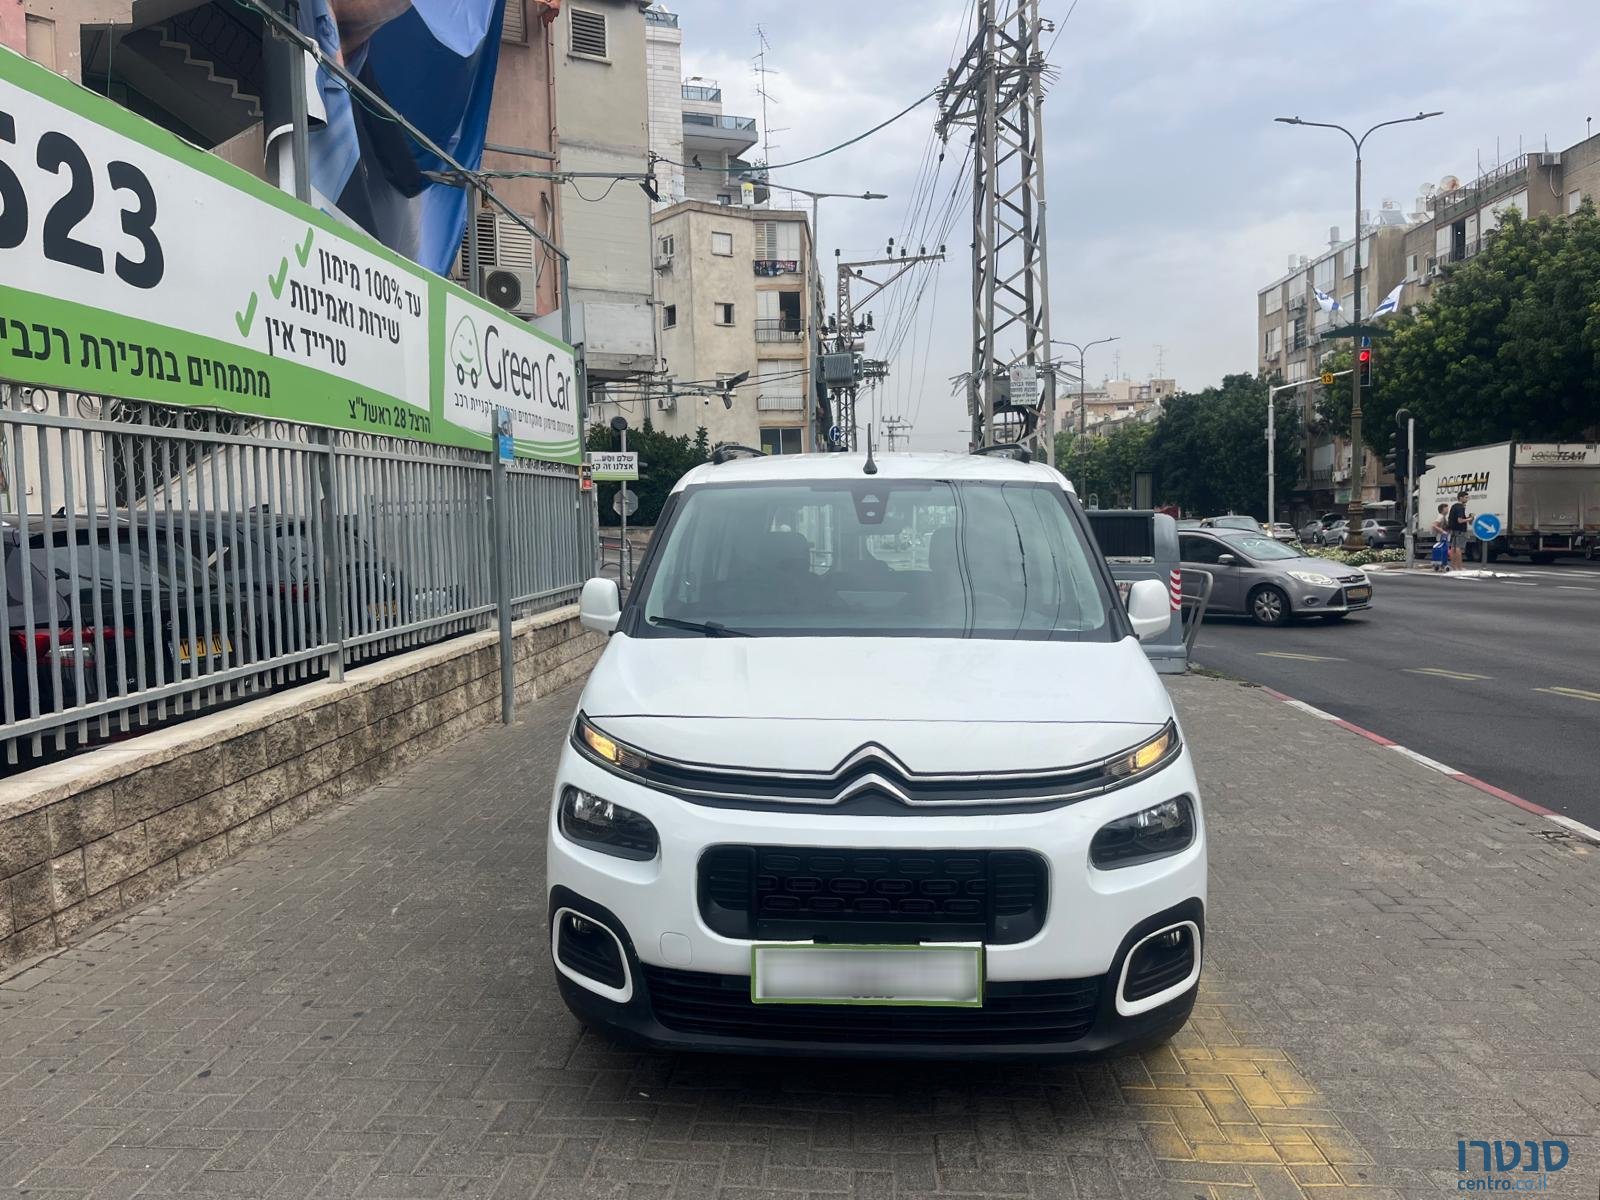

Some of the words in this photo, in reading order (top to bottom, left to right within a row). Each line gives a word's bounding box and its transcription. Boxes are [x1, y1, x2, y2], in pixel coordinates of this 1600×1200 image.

[318, 248, 361, 292] מימון
[365, 267, 402, 310] 100%
[290, 279, 354, 328] ואמינות
[404, 290, 421, 317] עד
[265, 316, 296, 356] אין
[358, 306, 400, 344] שירות
[79, 332, 181, 383] במכירת
[300, 327, 347, 366] טרייד
[187, 355, 271, 399] מתמחים
[484, 324, 542, 403] Green
[546, 353, 571, 412] Car
[1323, 374, 1332, 382] 13
[348, 396, 392, 426] ראשל"צ
[393, 405, 406, 429] 28
[454, 392, 469, 409] רכב
[408, 408, 431, 434] הרצל
[613, 462, 634, 470] אצלנו
[1436, 471, 1490, 495] LOGISTEAM
